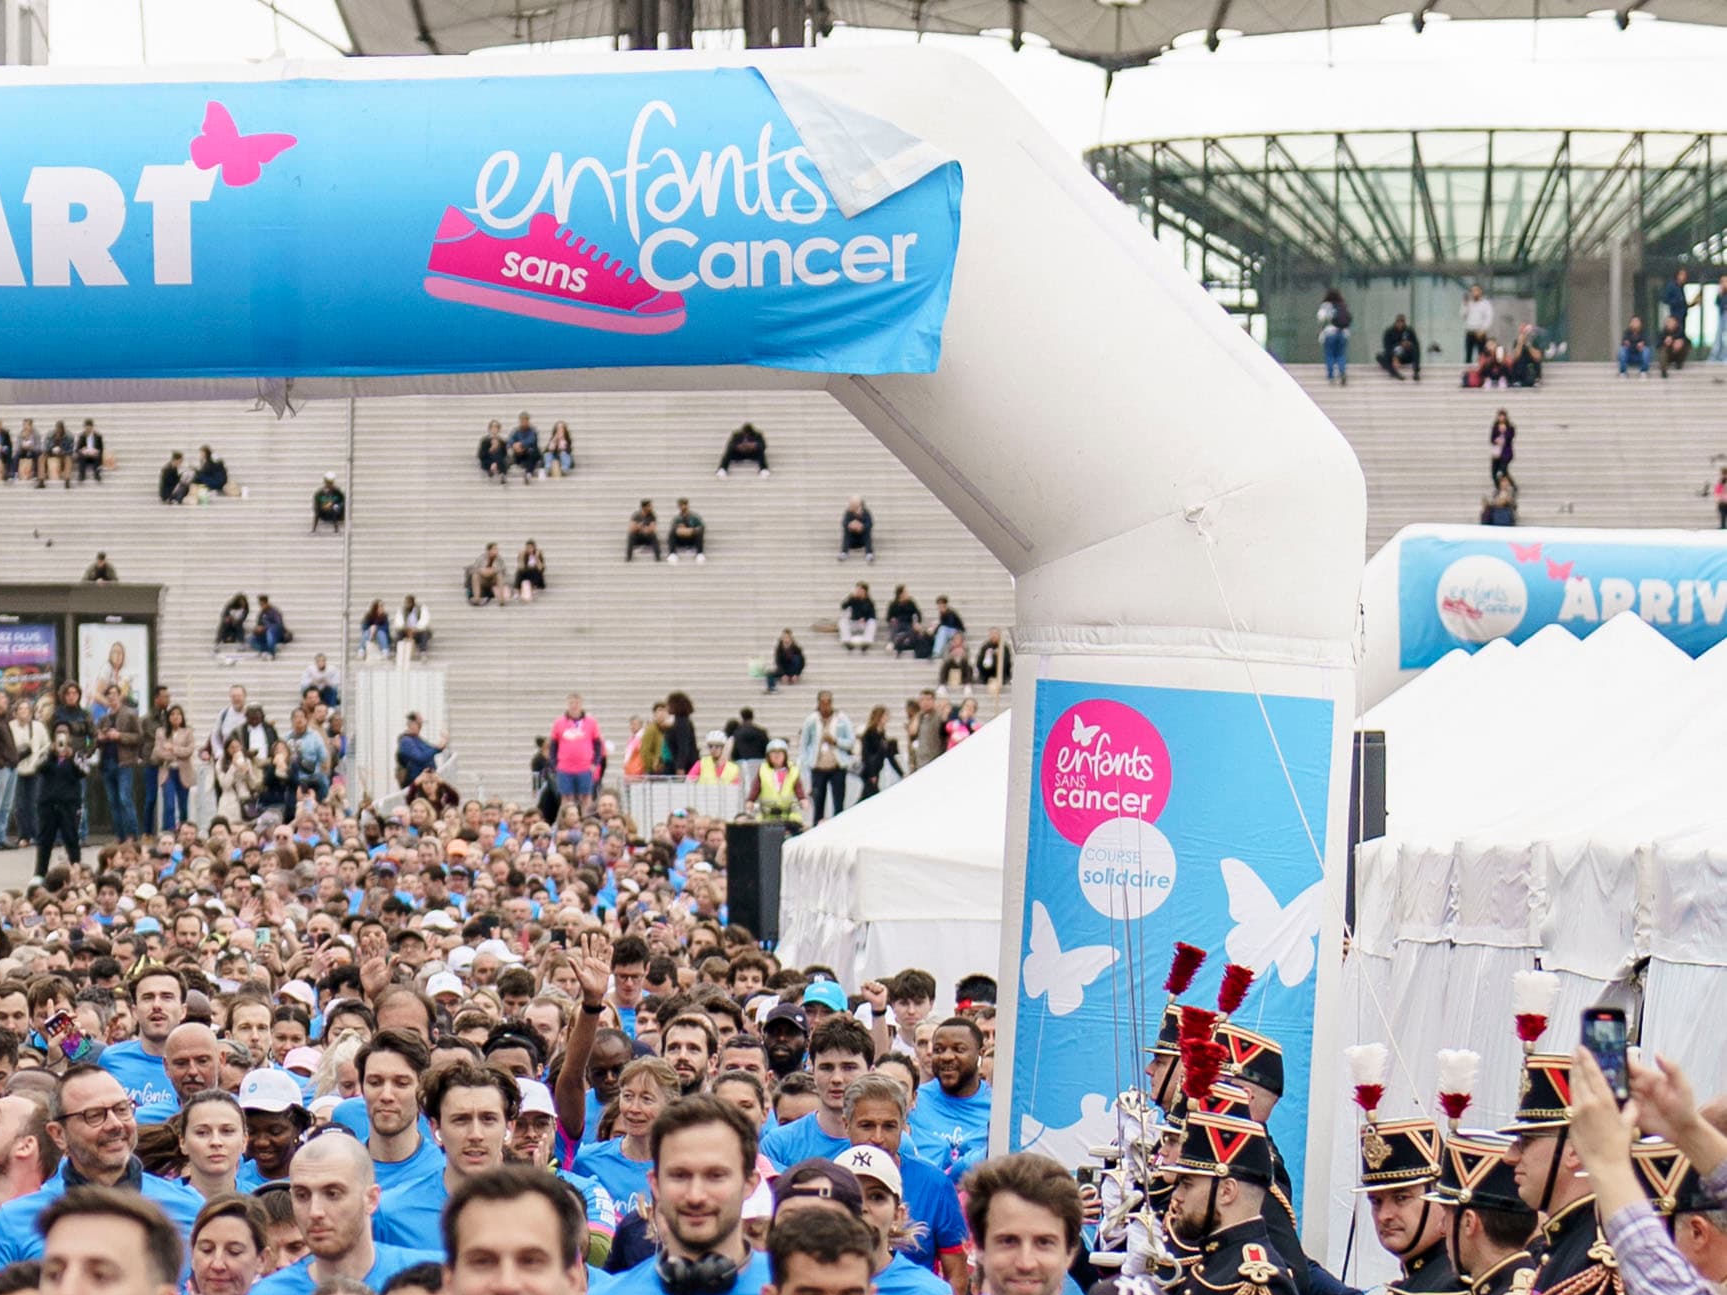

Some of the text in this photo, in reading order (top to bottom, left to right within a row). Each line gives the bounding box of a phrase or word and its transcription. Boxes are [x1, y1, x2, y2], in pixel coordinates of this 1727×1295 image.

[464, 100, 827, 245] enfants
[500, 248, 589, 294] sans
[639, 227, 918, 292] Cancer
[1057, 733, 1154, 782] enfants
[1055, 773, 1087, 789] SANS
[1053, 788, 1153, 813] cancer
[1084, 847, 1142, 865] COURSE
[1083, 868, 1171, 890] solidaire
[852, 1151, 872, 1167] NY
